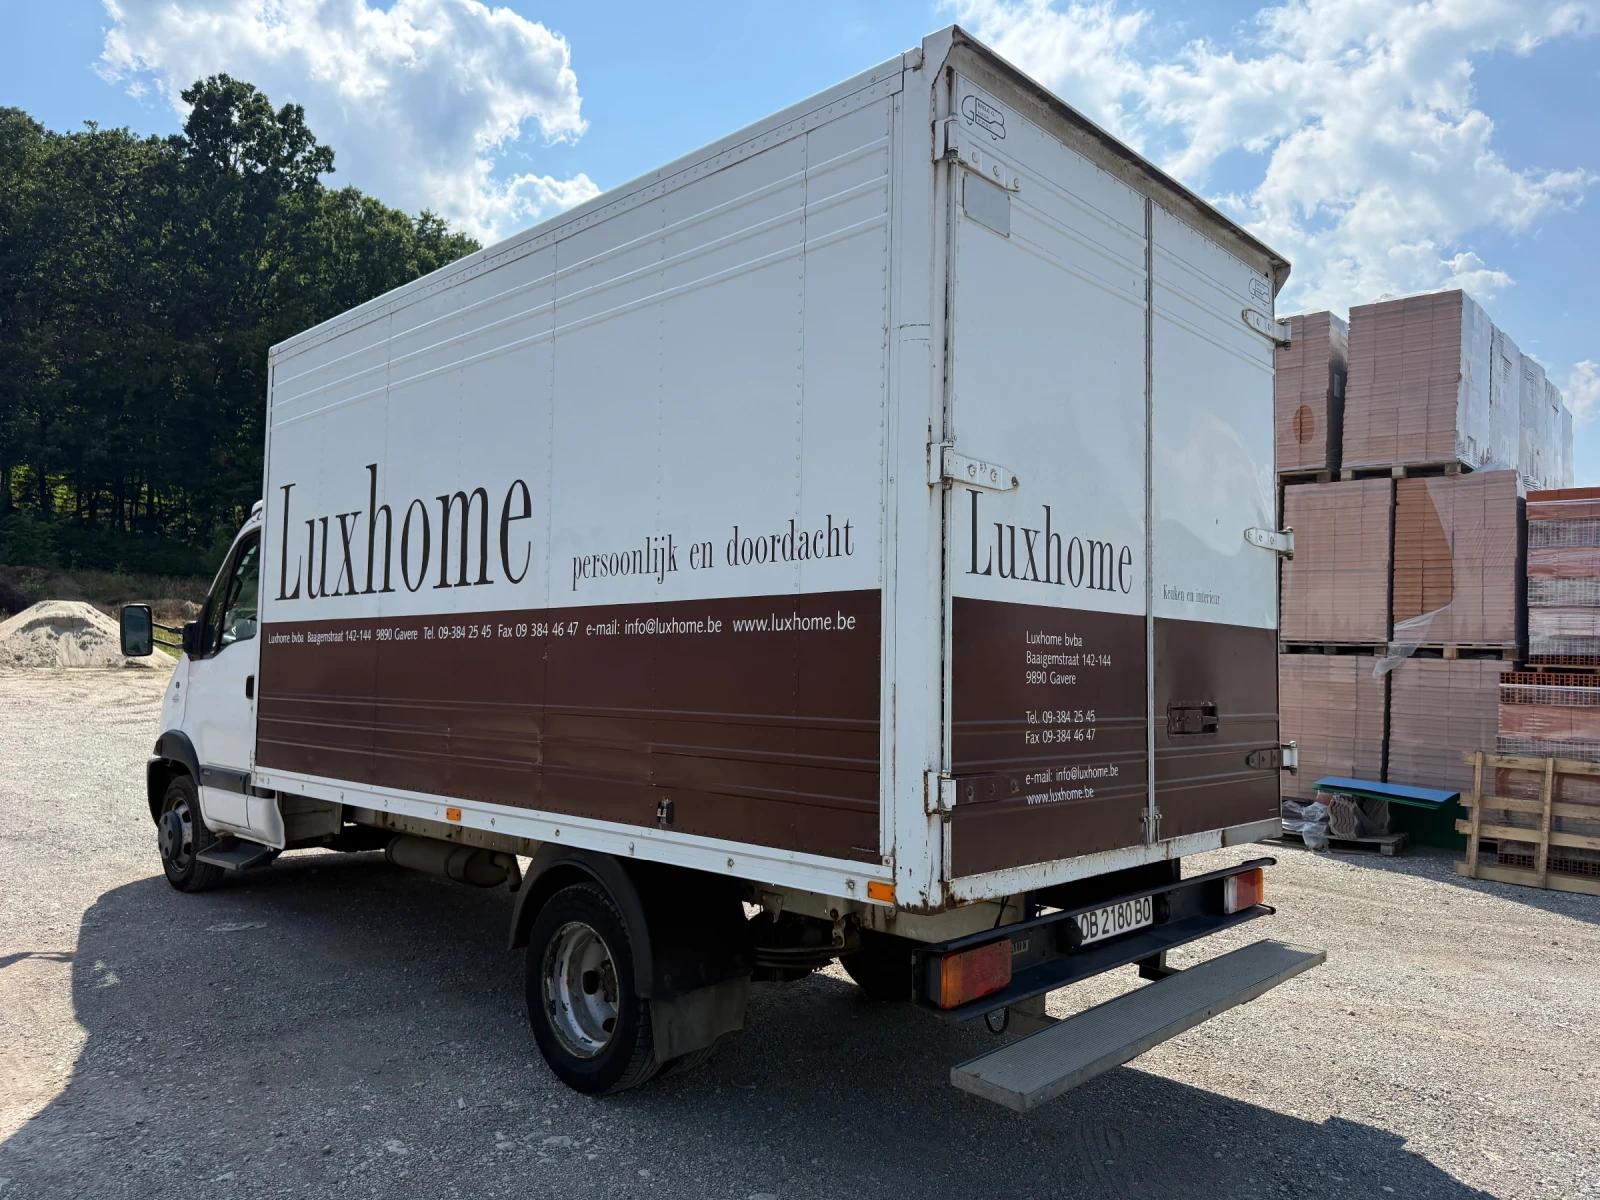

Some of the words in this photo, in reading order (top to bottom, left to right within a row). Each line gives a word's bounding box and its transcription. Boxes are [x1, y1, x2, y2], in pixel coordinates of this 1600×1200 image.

[275, 463, 533, 601] Luxhome
[965, 489, 1133, 594] Luxhome
[572, 533, 678, 591] persoonlijk
[689, 544, 713, 570] en
[727, 514, 855, 566] doordacht
[1187, 591, 1194, 602] en
[268, 632, 290, 644] Luxhome
[291, 632, 304, 643] bvba
[345, 630, 371, 641] 142-144
[376, 629, 392, 640] 9890
[394, 628, 418, 640] Gavere
[424, 627, 436, 639] Tel.
[438, 626, 465, 639] 09-384
[468, 625, 478, 638] 25
[481, 625, 492, 637] 45
[498, 624, 512, 637] Fax
[515, 624, 527, 637] 09
[531, 623, 548, 637] 384
[552, 622, 564, 636] 46
[567, 622, 579, 636] 47
[586, 620, 620, 636] e-mail:
[625, 616, 722, 635] info@luxhome.be
[733, 610, 856, 632] www.luxhome.be
[1026, 631, 1062, 645] Luxhome
[1064, 633, 1082, 646] bvba
[1026, 651, 1079, 668] Baaigemstraat
[1082, 654, 1111, 666] 142-144
[1026, 672, 1046, 683] 9890
[1050, 672, 1076, 684] Gavere
[1026, 711, 1040, 724] Tel.
[1042, 711, 1070, 723] 09-384
[1074, 711, 1083, 722] 25
[1086, 710, 1096, 722] 45
[1026, 731, 1040, 744] Fax
[1042, 730, 1071, 743] 09-384
[1074, 729, 1084, 741] 46
[1086, 729, 1096, 740] 47
[1026, 769, 1053, 784] e-mail:
[1056, 764, 1118, 781] info@luxhome.be
[1026, 787, 1094, 804] www.luxhome.be
[1081, 912, 1098, 940] OB
[1102, 902, 1132, 935] 2180
[1135, 898, 1150, 924] BO
